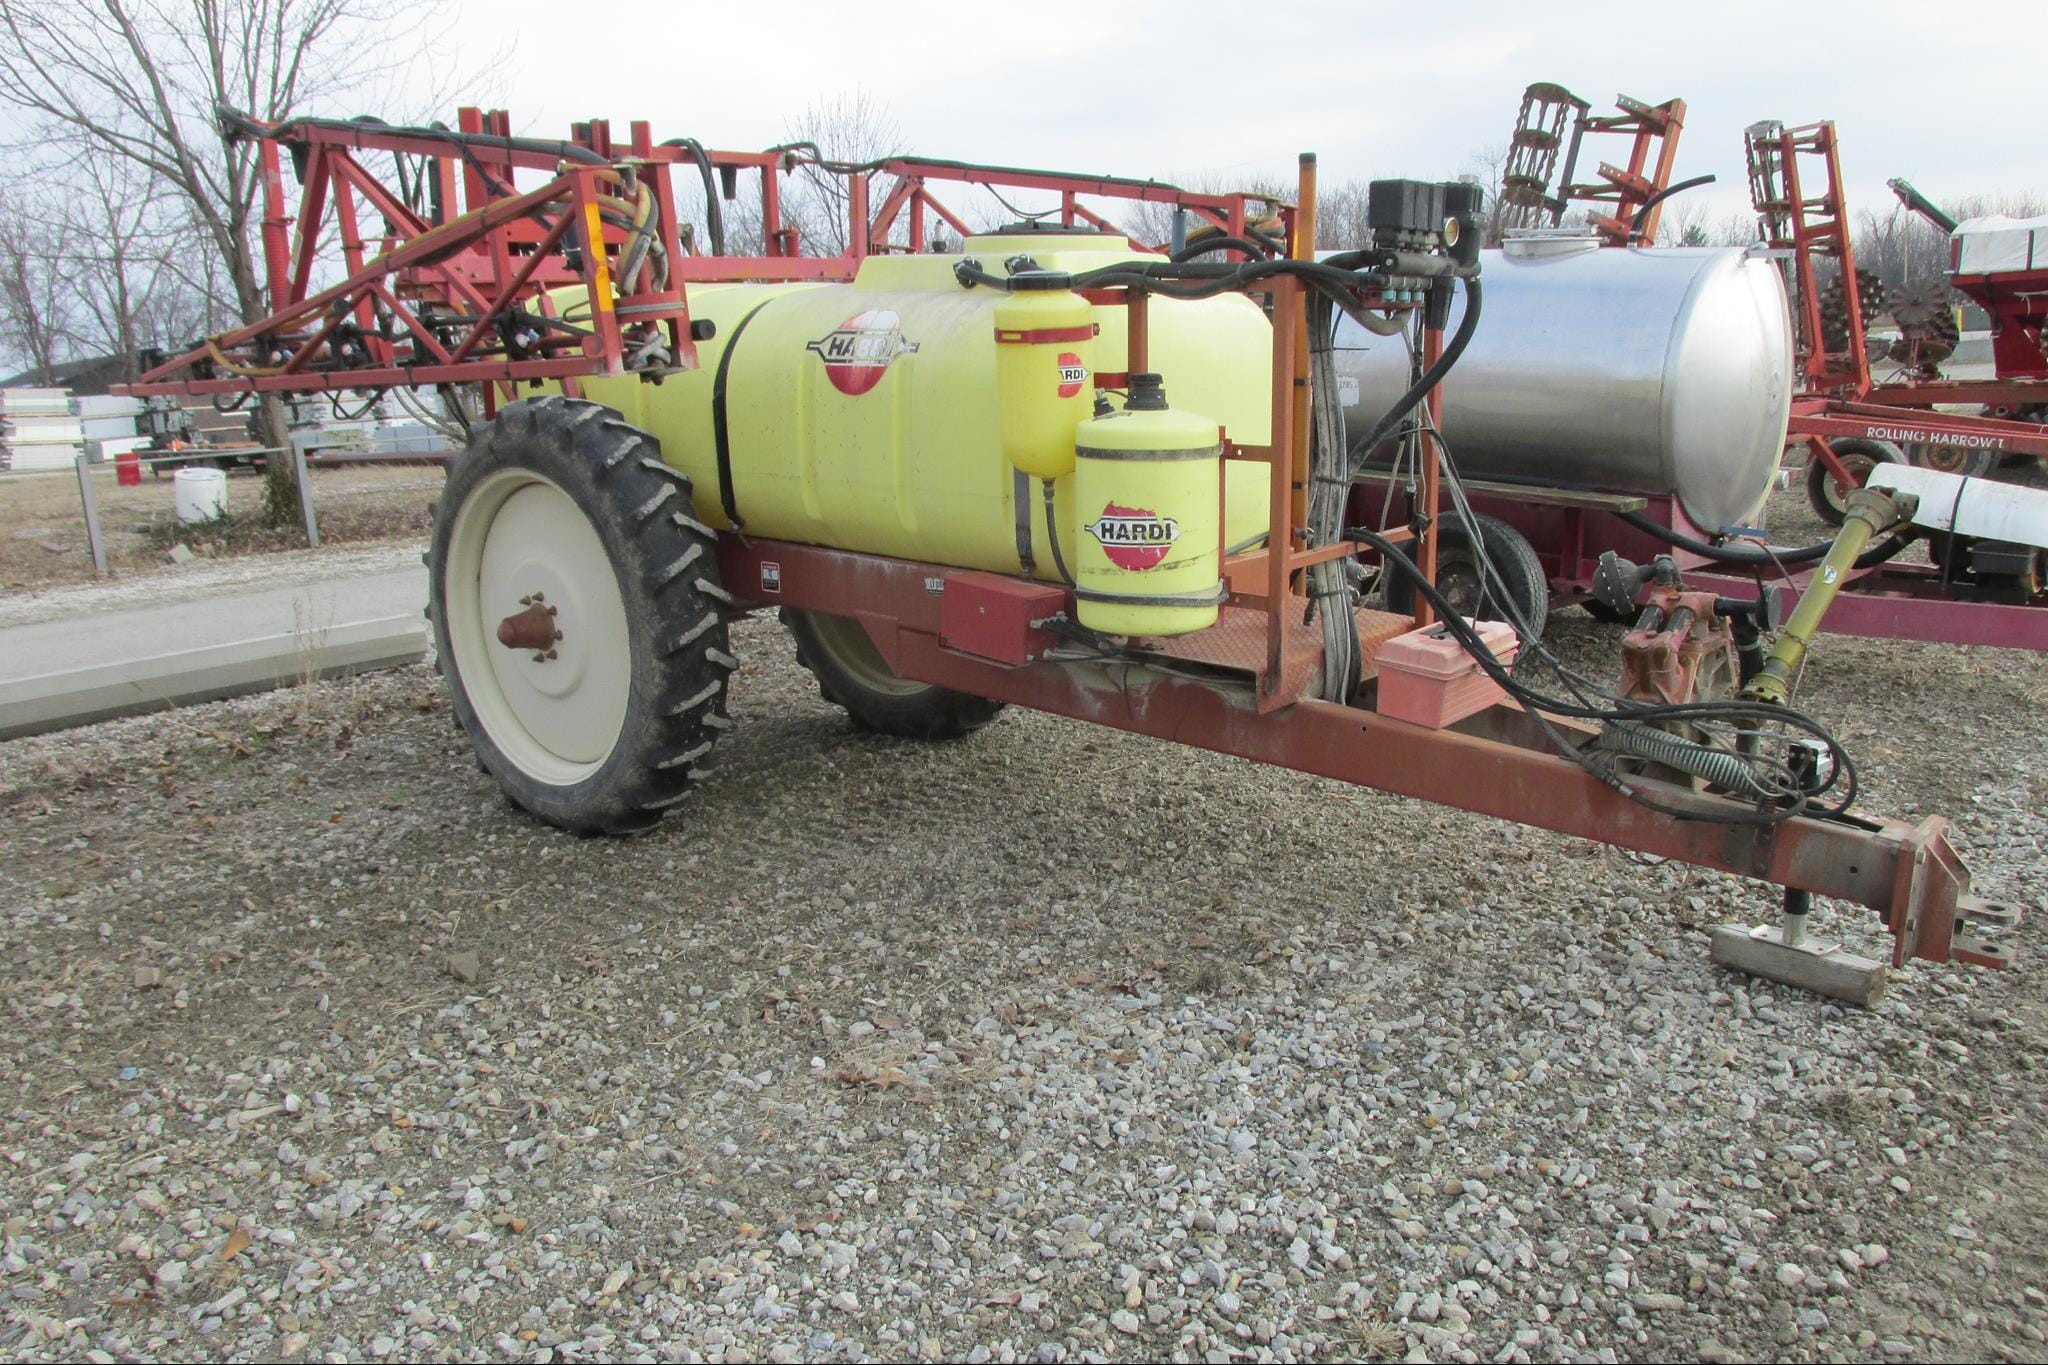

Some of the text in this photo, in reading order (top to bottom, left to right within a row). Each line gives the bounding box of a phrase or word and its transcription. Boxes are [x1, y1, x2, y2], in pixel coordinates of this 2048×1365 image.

[1866, 427, 1925, 442] ROLLING
[1930, 433, 1993, 449] HARROW
[1101, 522, 1171, 540] HARDI
